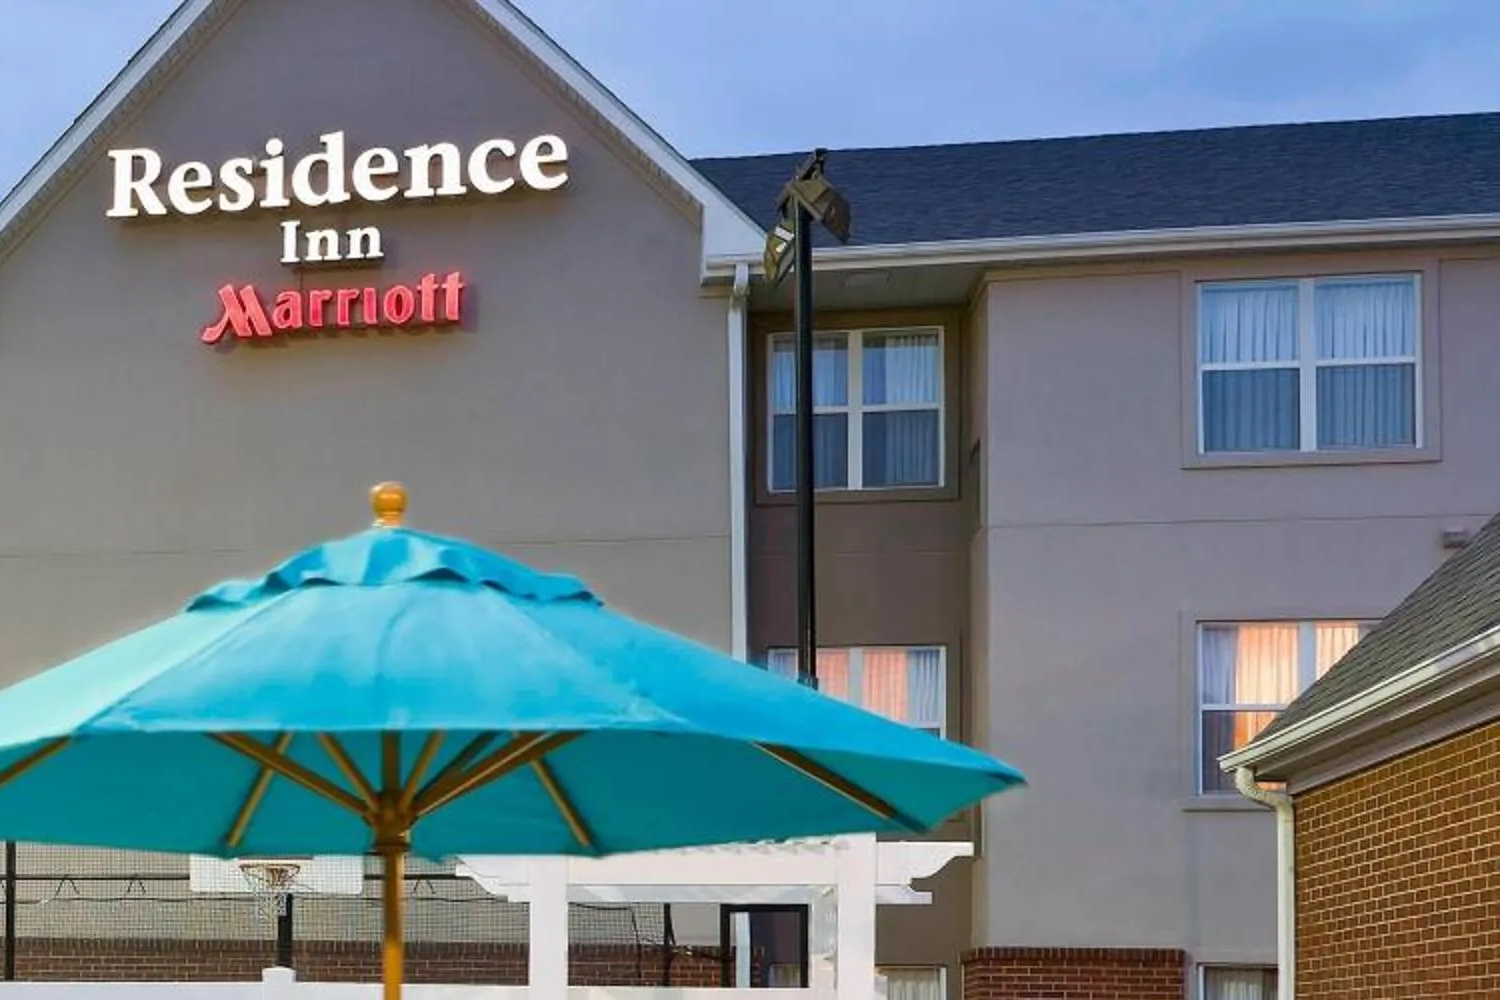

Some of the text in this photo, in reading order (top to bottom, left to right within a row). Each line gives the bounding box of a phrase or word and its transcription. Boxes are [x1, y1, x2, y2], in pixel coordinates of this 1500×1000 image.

[106, 131, 568, 217] Residence
[280, 220, 384, 263] Inn
[201, 271, 466, 344] Marriott
